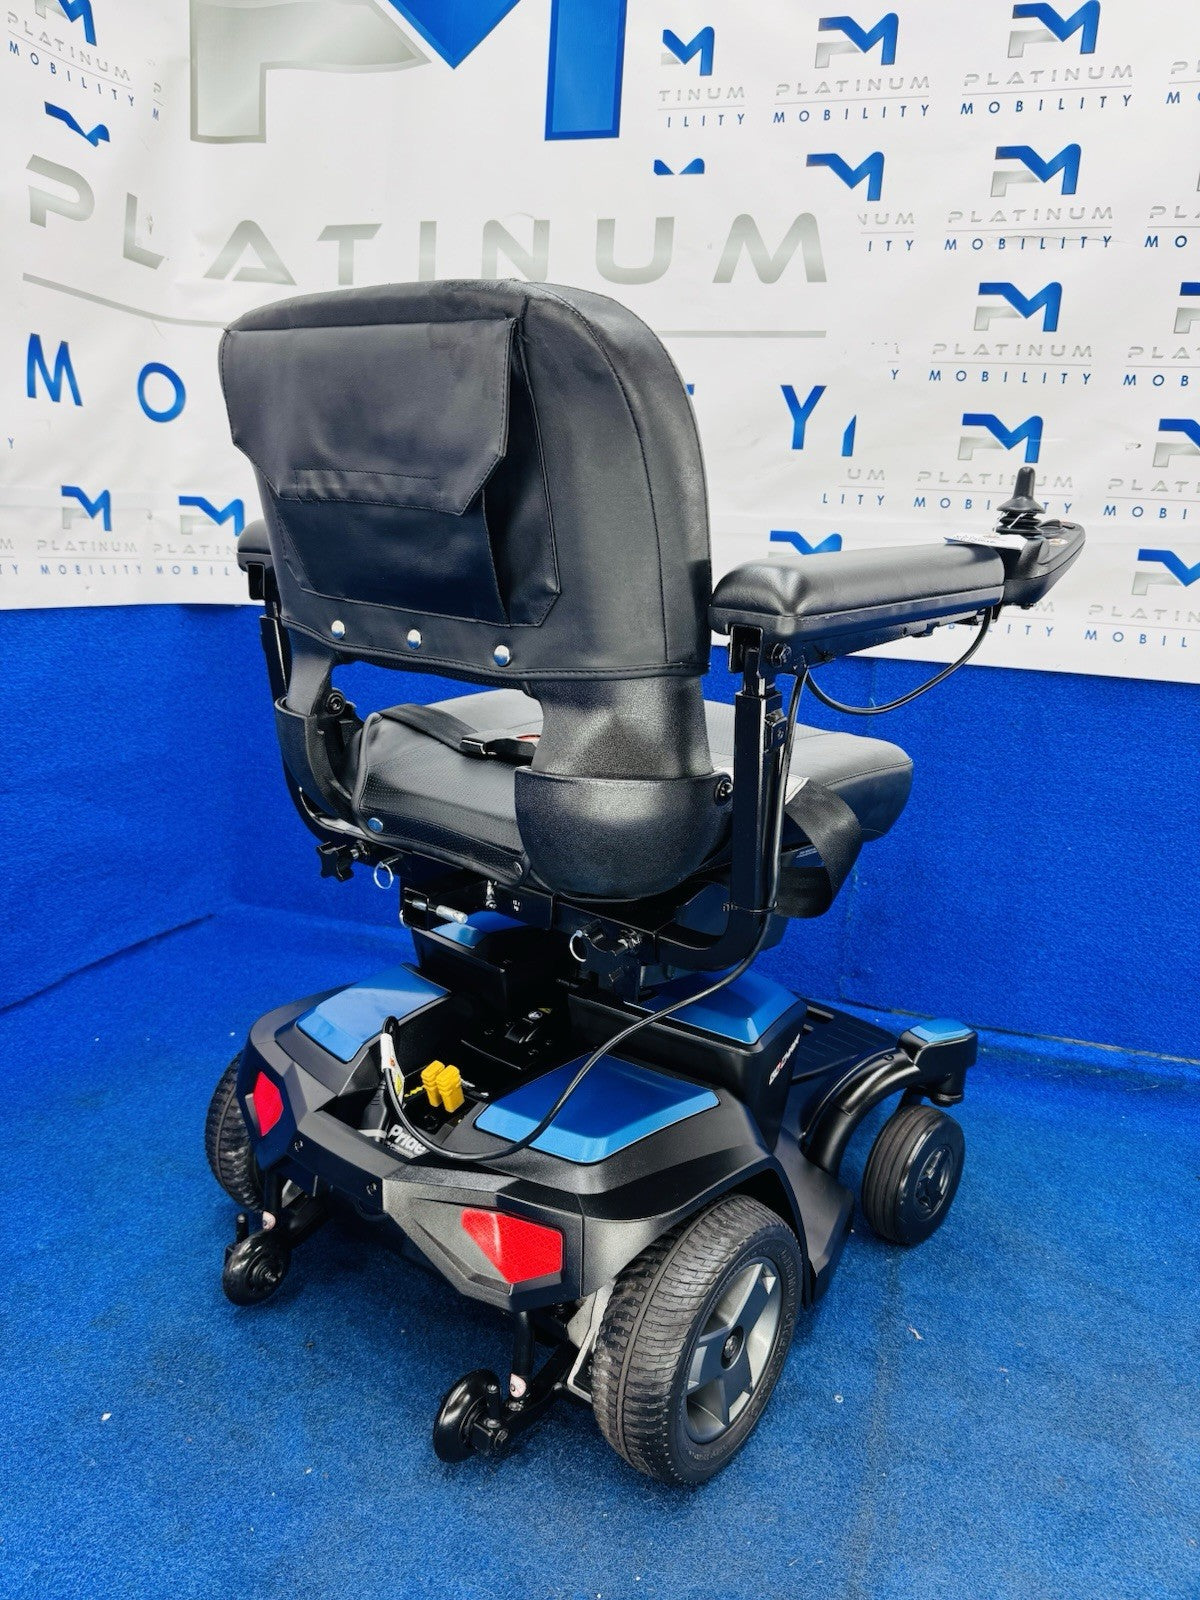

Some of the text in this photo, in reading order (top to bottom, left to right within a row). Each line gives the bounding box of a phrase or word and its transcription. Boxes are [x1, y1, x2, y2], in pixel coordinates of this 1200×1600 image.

[8, 11, 131, 81] PLATINUM
[9, 41, 135, 107] MOBILITY
[964, 65, 1133, 87] PLATINUM
[776, 76, 930, 96] PLATINUM
[773, 105, 930, 123] MOBILITY
[960, 95, 1132, 115] MOBILITY
[26, 154, 825, 286] PLATINUM
[948, 206, 1113, 223] PLATINUM
[944, 235, 1112, 250] MOBILITY
[931, 343, 1093, 358] PLATINUM
[928, 370, 1092, 386] MOBILITY
[37, 539, 137, 553] PLATINUM
[40, 564, 142, 575] MOBILITY
